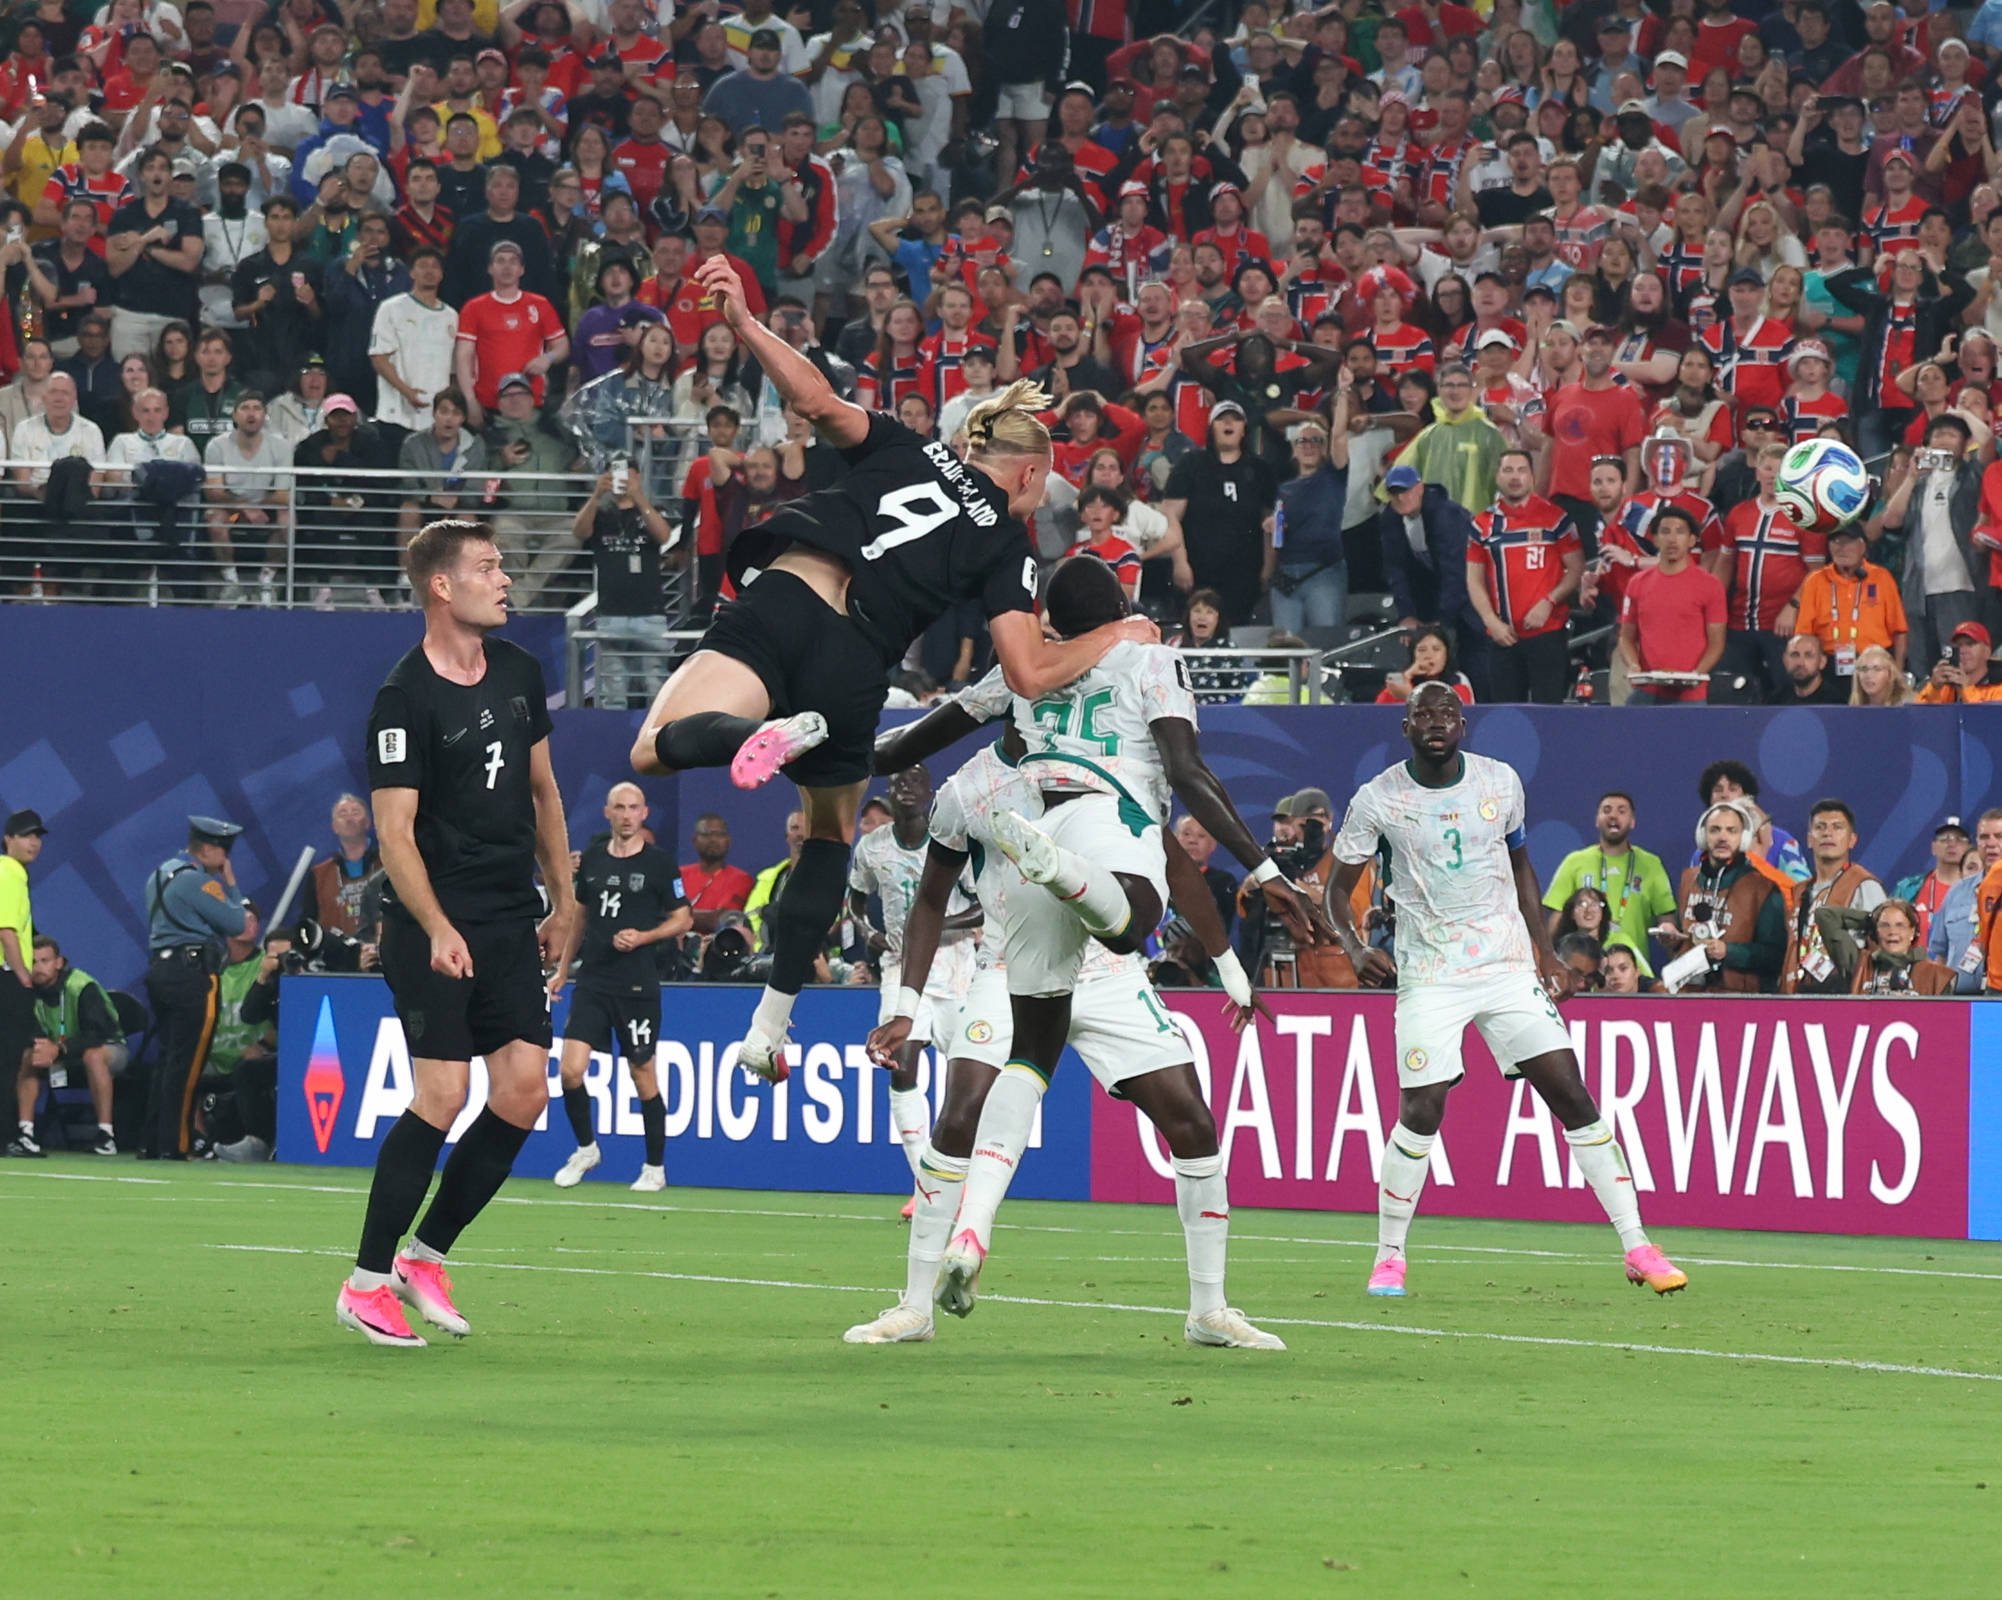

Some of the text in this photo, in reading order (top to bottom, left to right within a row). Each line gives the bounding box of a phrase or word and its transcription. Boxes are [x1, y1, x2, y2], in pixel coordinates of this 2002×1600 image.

[1223, 481, 1238, 502] 9
[860, 479, 961, 562] 9
[1525, 545, 1546, 570] 21
[484, 740, 505, 790] 7
[1443, 827, 1464, 870] 3
[599, 889, 622, 918] 14
[900, 878, 920, 912] 1
[627, 1017, 652, 1047] 14
[532, 1035, 1042, 1149] PREDICTSTR
[1135, 1010, 1922, 1206] QATA AIRWAYS
